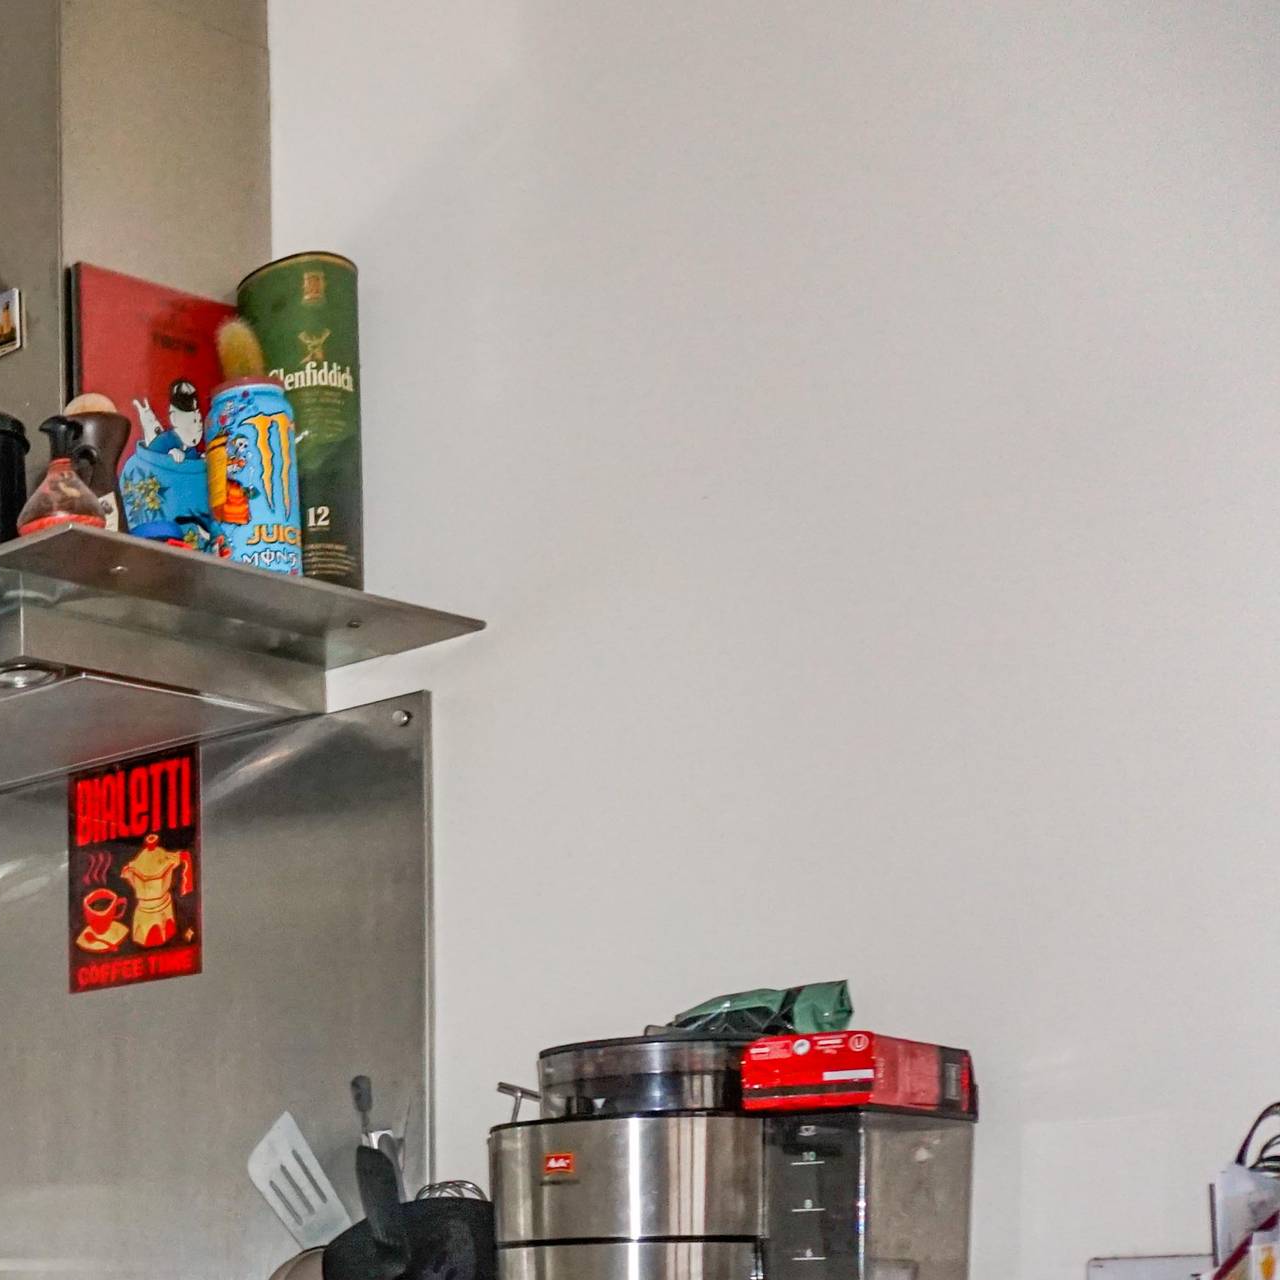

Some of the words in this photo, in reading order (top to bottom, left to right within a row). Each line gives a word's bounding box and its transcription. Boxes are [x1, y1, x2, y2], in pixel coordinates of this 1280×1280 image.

[307, 506, 330, 527] 12
[246, 523, 302, 545] JUIC
[76, 757, 190, 847] BIALETTI
[78, 954, 145, 988] COFFEE
[149, 946, 196, 975] TIME
